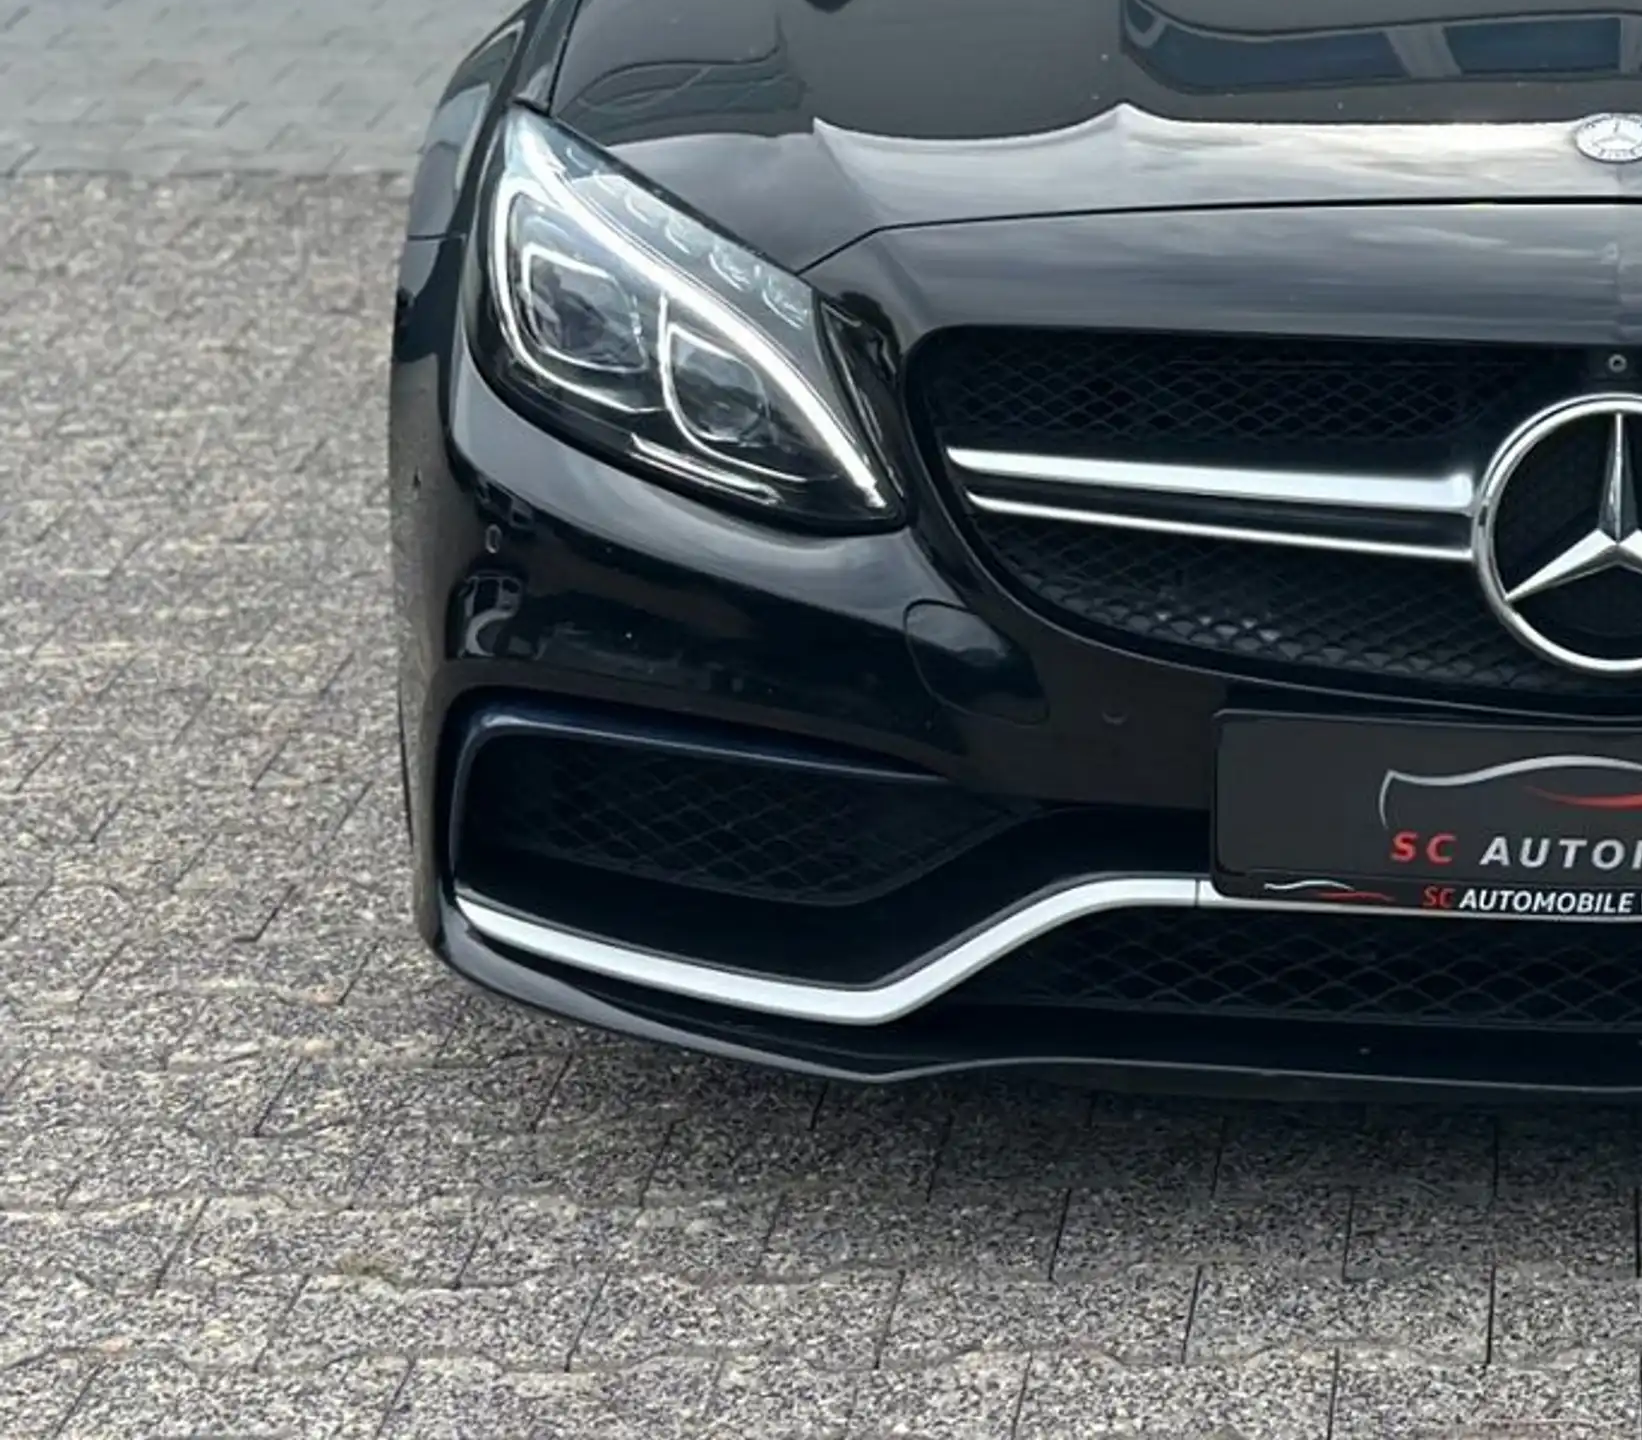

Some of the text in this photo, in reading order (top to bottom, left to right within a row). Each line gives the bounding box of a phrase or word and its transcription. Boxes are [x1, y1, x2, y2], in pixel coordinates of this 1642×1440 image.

[1390, 830, 1457, 863] SC
[1423, 885, 1457, 908] SC
[1458, 887, 1635, 914] AUTOMOBILE
